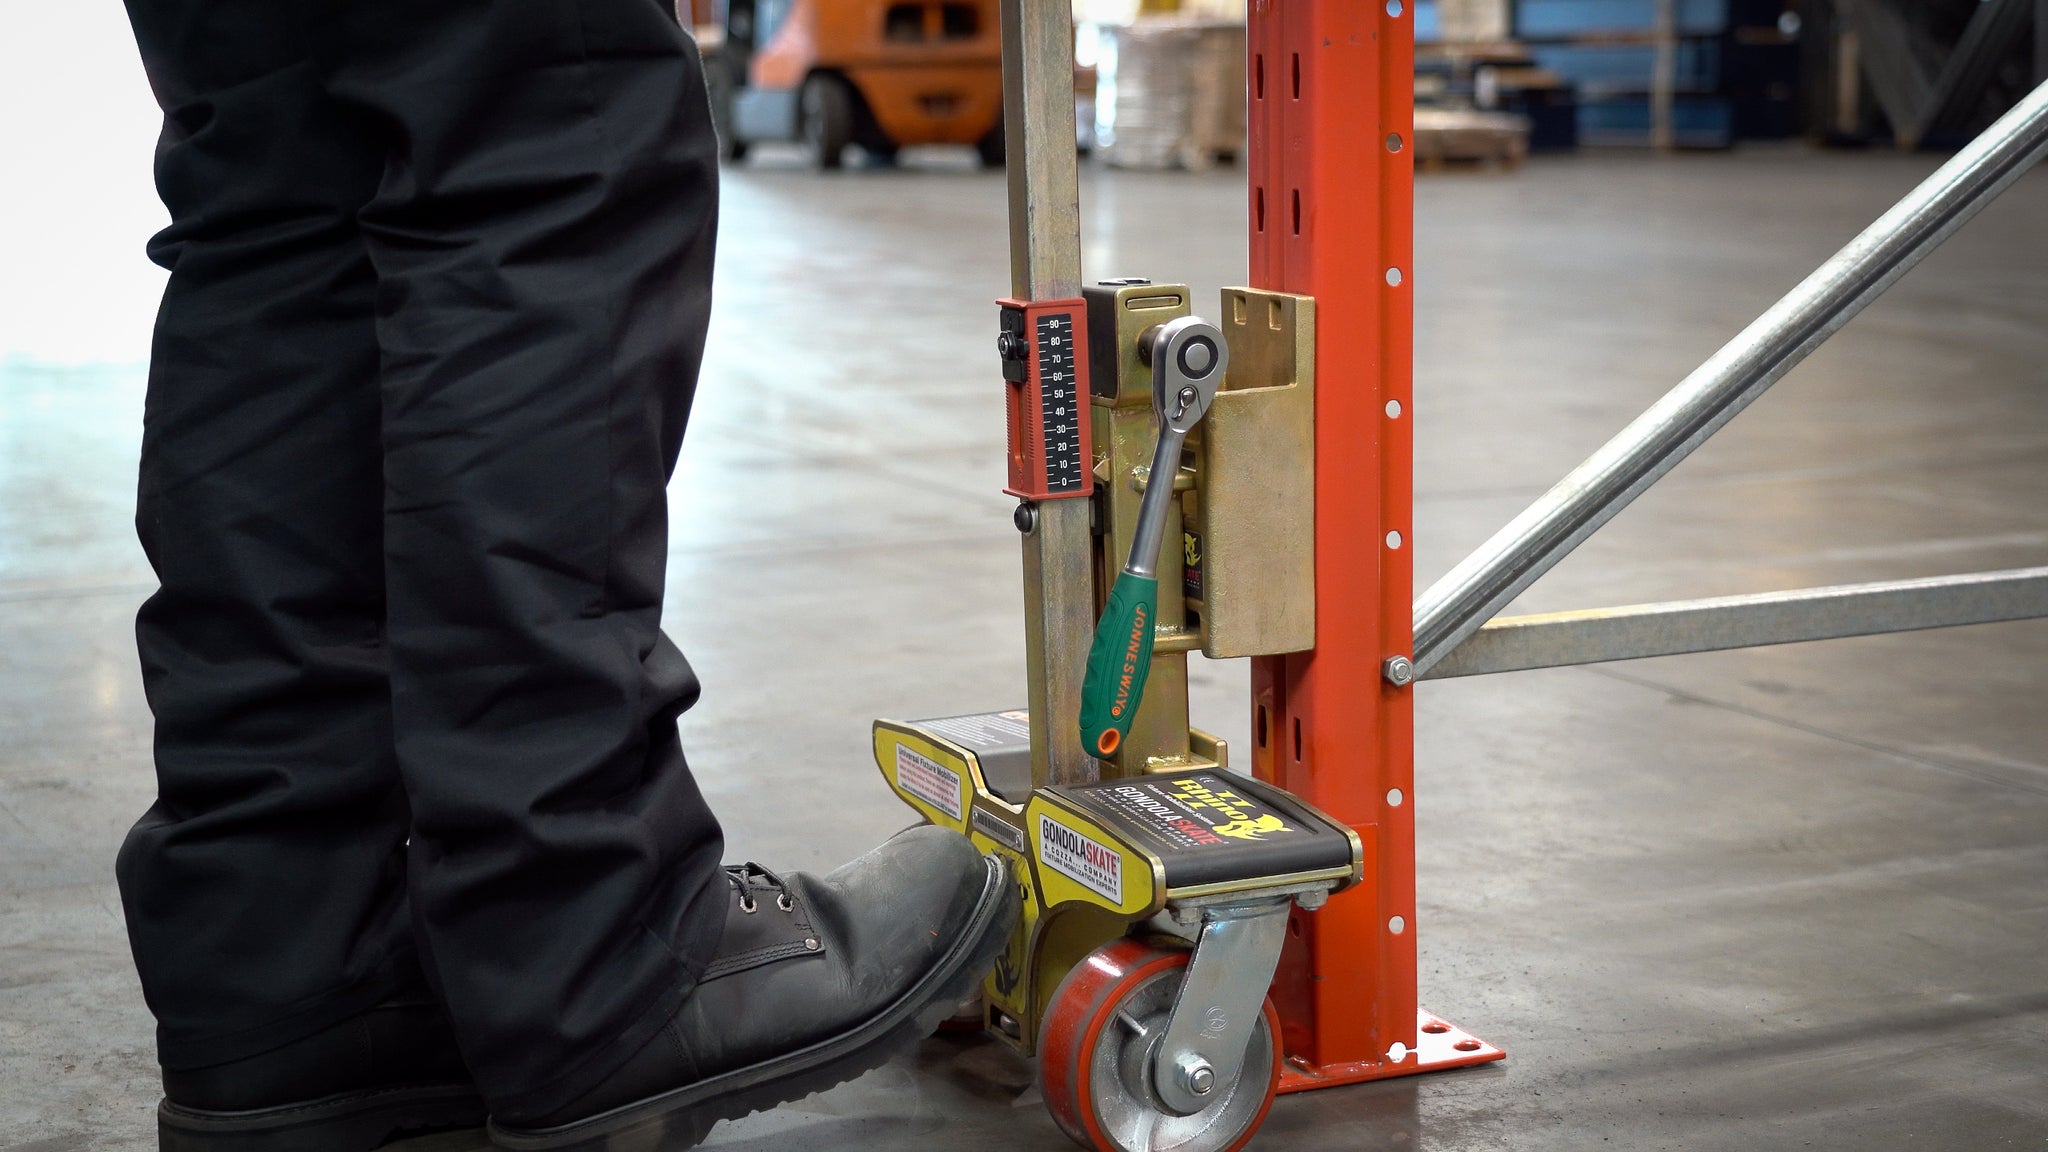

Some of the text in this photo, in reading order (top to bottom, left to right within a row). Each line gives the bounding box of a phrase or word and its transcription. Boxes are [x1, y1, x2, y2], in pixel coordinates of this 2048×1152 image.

[1049, 319, 1060, 329] 90
[1050, 337, 1061, 346] 80
[1052, 355, 1061, 363] 70
[1053, 372, 1063, 381] 60
[1054, 389, 1064, 398] 50
[1055, 407, 1065, 416] 40
[1056, 425, 1066, 434] 30
[1057, 442, 1067, 451] 20
[1059, 460, 1068, 469] 10
[1061, 478, 1067, 486] 0
[1171, 779, 1249, 820] Rhino
[1044, 851, 1117, 895] FIXTURE MOBILIZATION EXPERTS
[1083, 864, 1117, 887] COMPANY
